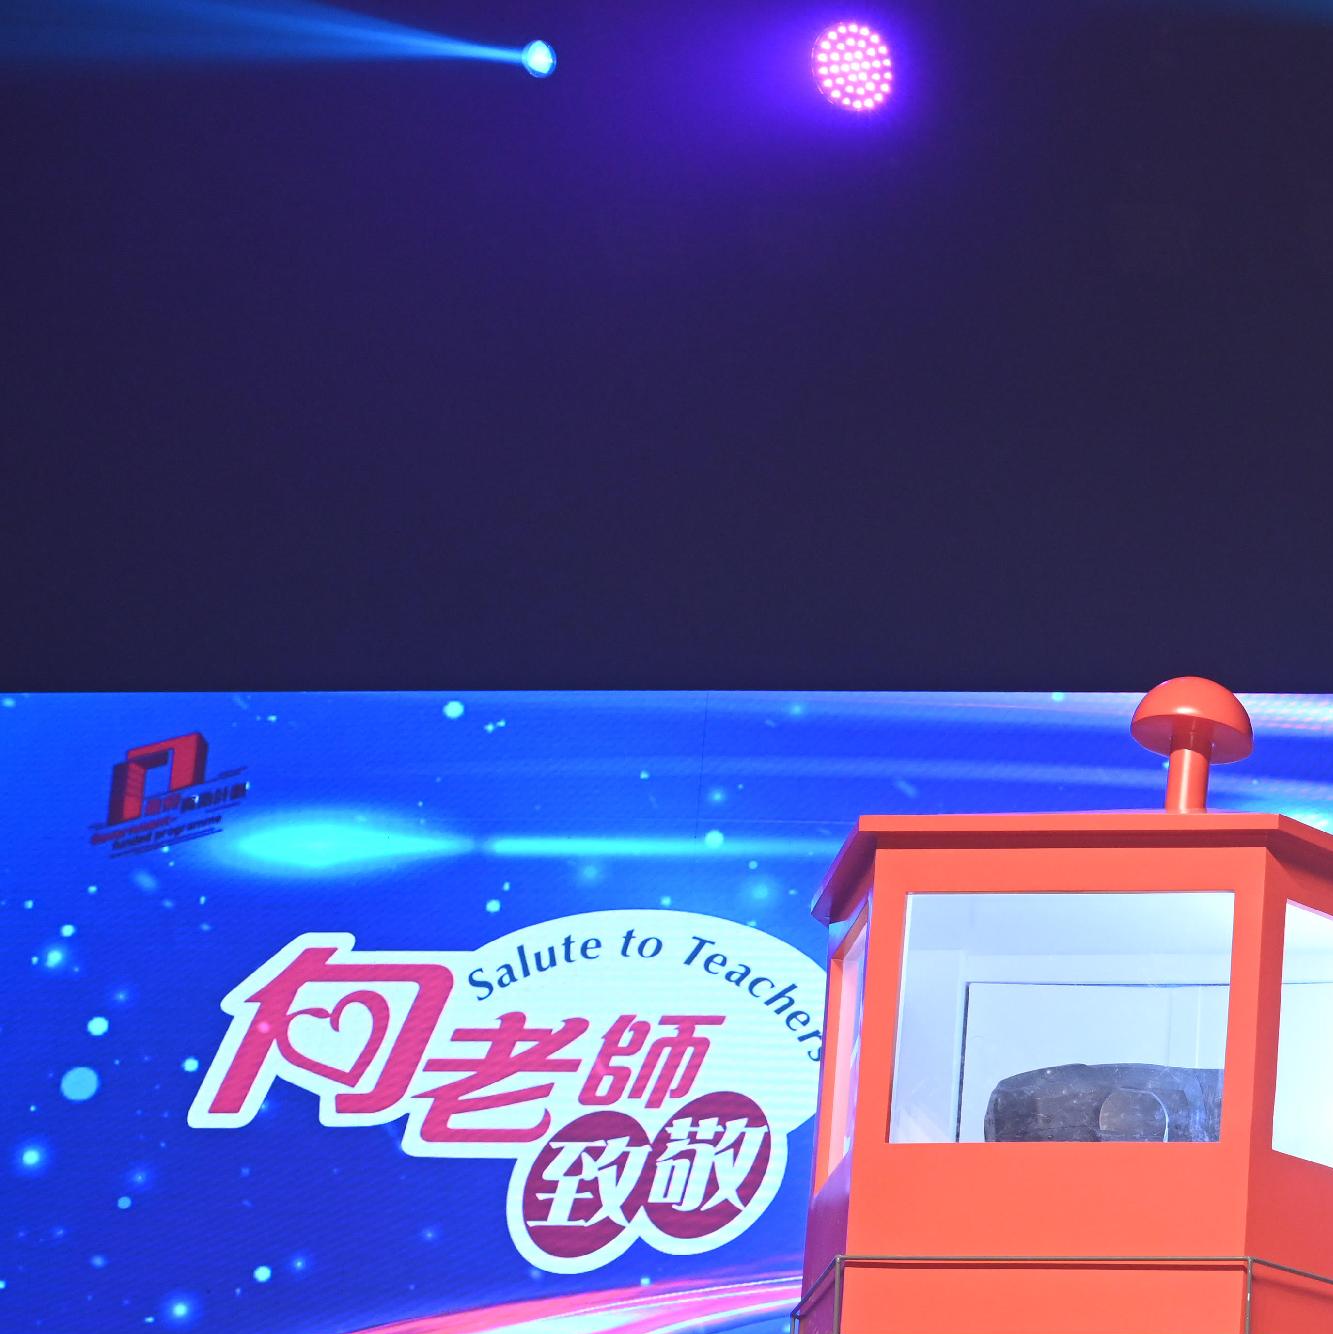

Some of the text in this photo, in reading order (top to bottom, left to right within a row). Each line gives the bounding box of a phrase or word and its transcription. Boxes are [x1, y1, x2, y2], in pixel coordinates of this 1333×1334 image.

[467, 928, 823, 1062] Salute to Teachers
